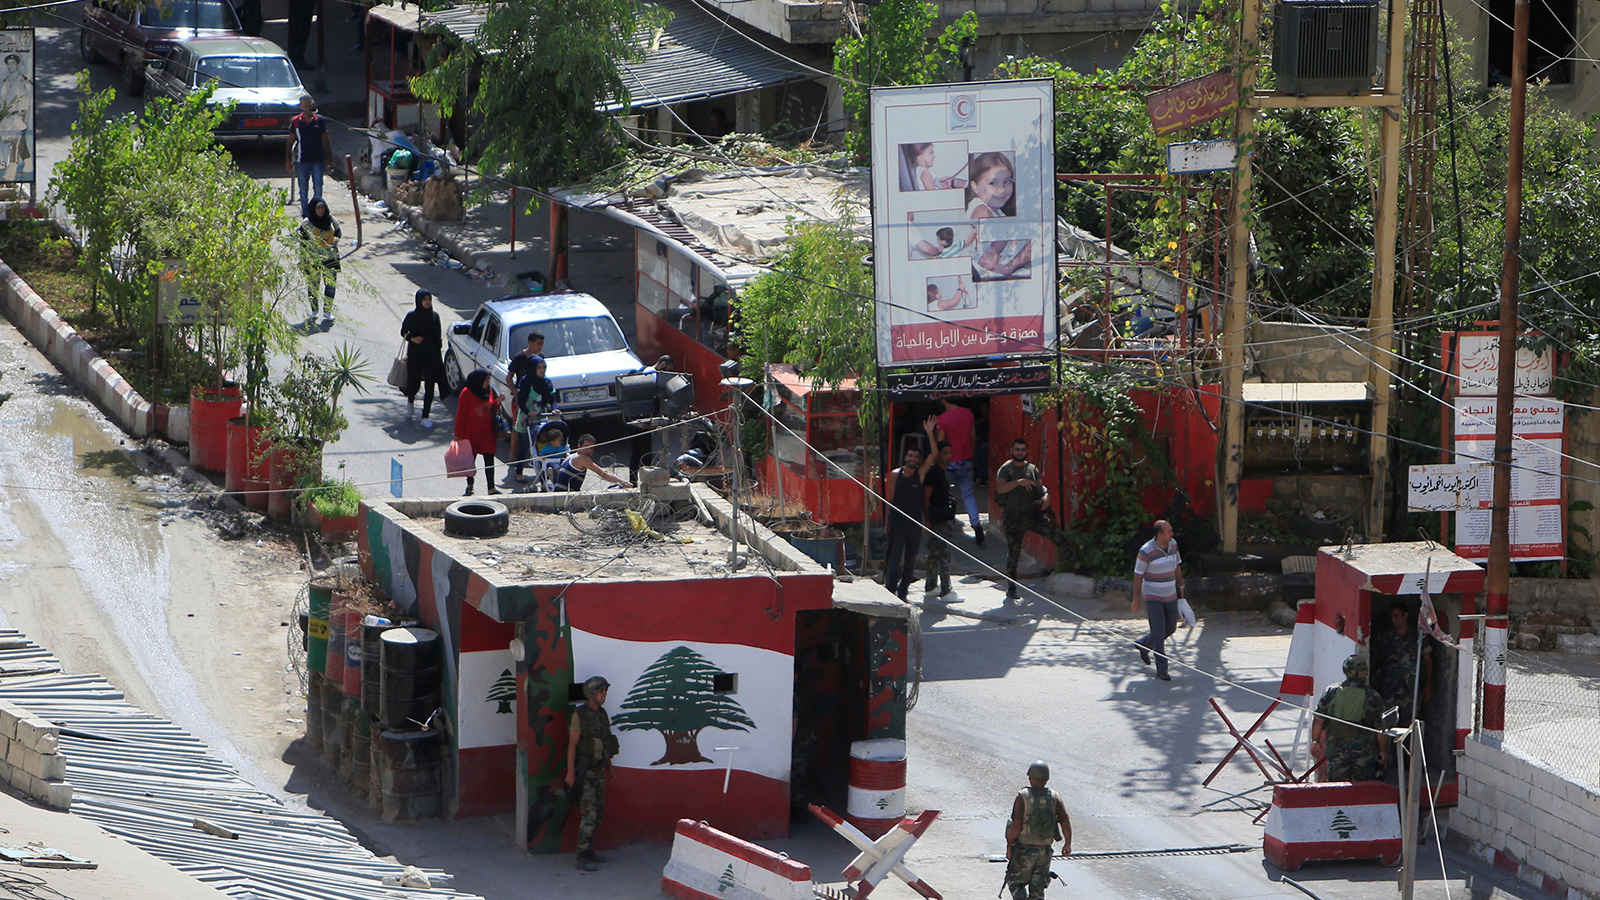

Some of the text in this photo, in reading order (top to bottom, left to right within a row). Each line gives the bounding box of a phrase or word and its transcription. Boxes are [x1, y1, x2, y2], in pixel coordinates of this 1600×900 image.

[896, 331, 933, 350] والحياة
[962, 333, 978, 346] بين
[979, 326, 1007, 345] وصل
[1009, 327, 1038, 342] همزة
[891, 374, 938, 395] الفلسطيني
[951, 374, 977, 389] الهلال
[1461, 405, 1493, 417] النجاح
[1459, 475, 1479, 491] الدكتور
